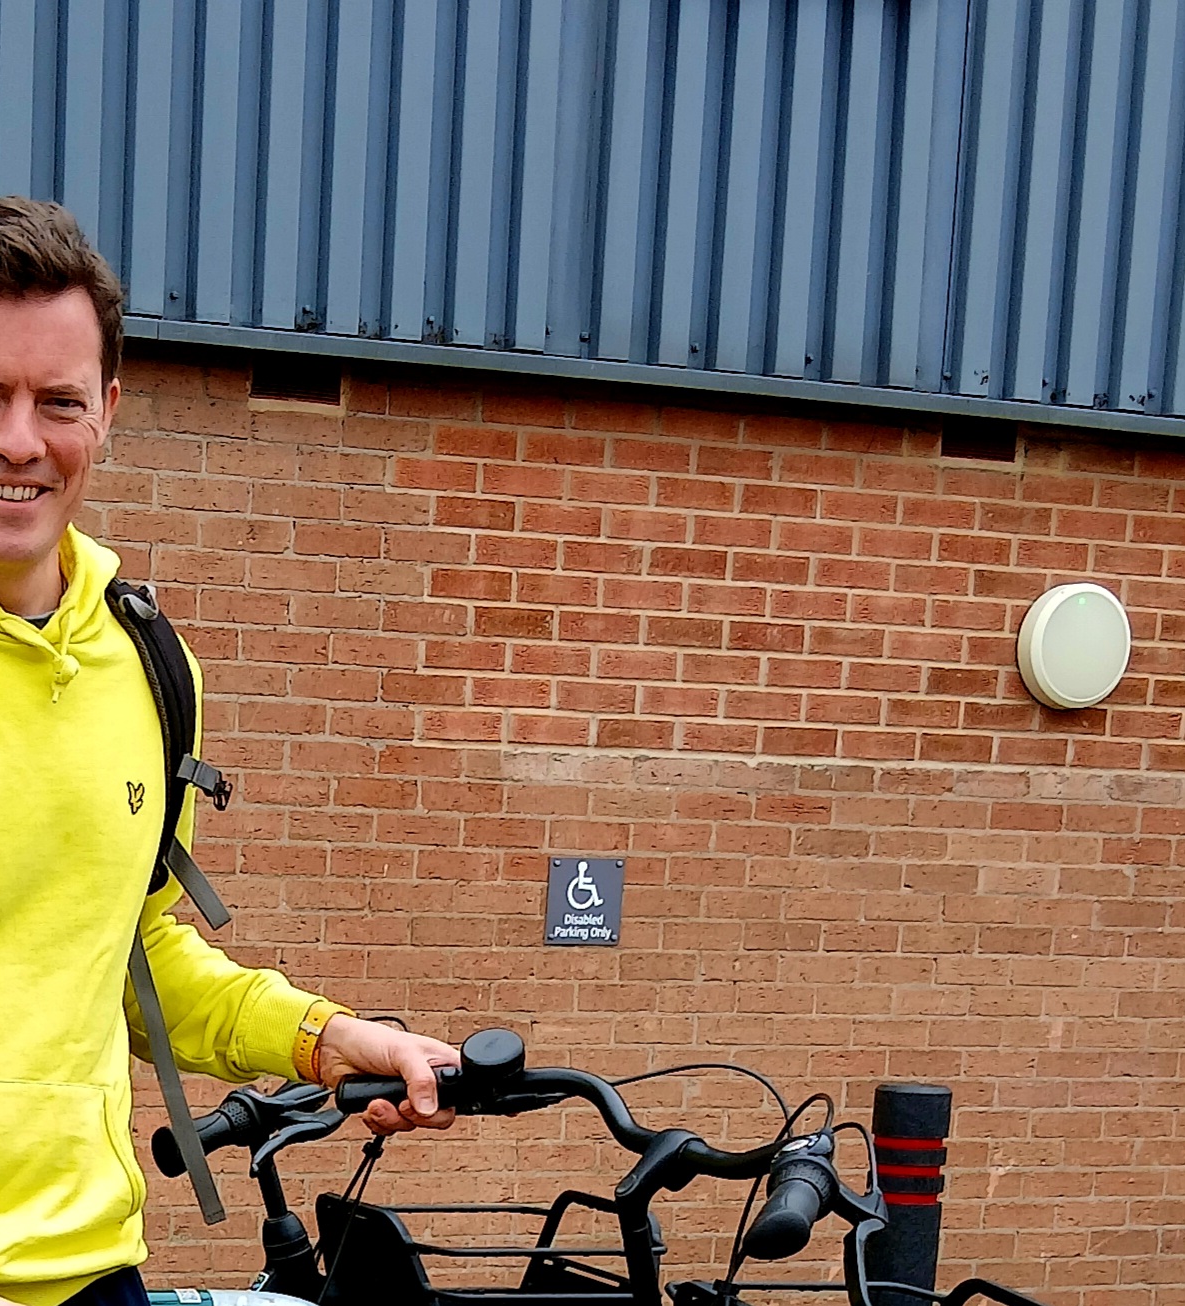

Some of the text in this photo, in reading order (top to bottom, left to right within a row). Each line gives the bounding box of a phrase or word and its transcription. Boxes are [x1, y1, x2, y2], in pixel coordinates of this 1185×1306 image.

[564, 914, 603, 925] Disabled
[554, 926, 611, 940] Parking Only
